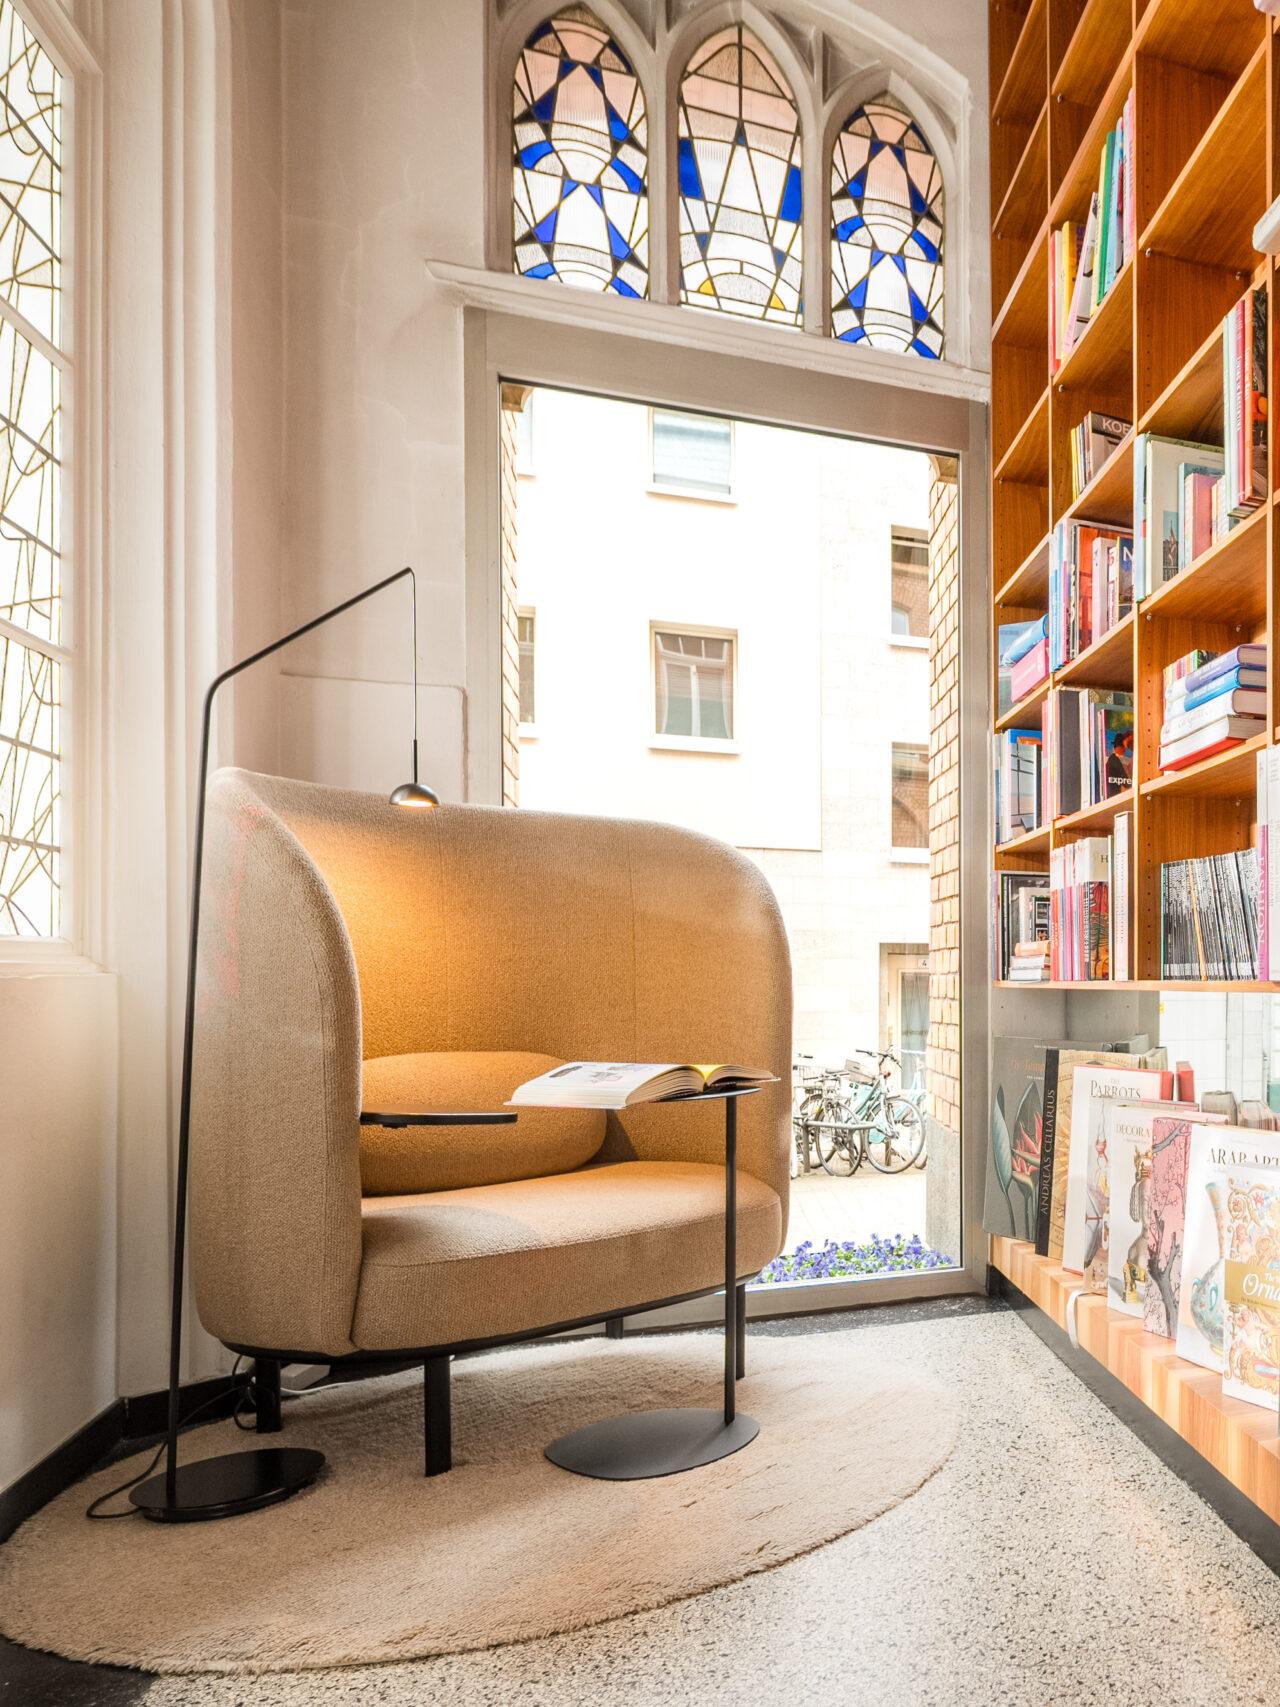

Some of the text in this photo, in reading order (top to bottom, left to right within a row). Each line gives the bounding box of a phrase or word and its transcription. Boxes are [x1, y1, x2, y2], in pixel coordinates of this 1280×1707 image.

[1089, 1079, 1142, 1098] PARROTS
[1040, 1089, 1055, 1215] ANDREAS CELLARIUS
